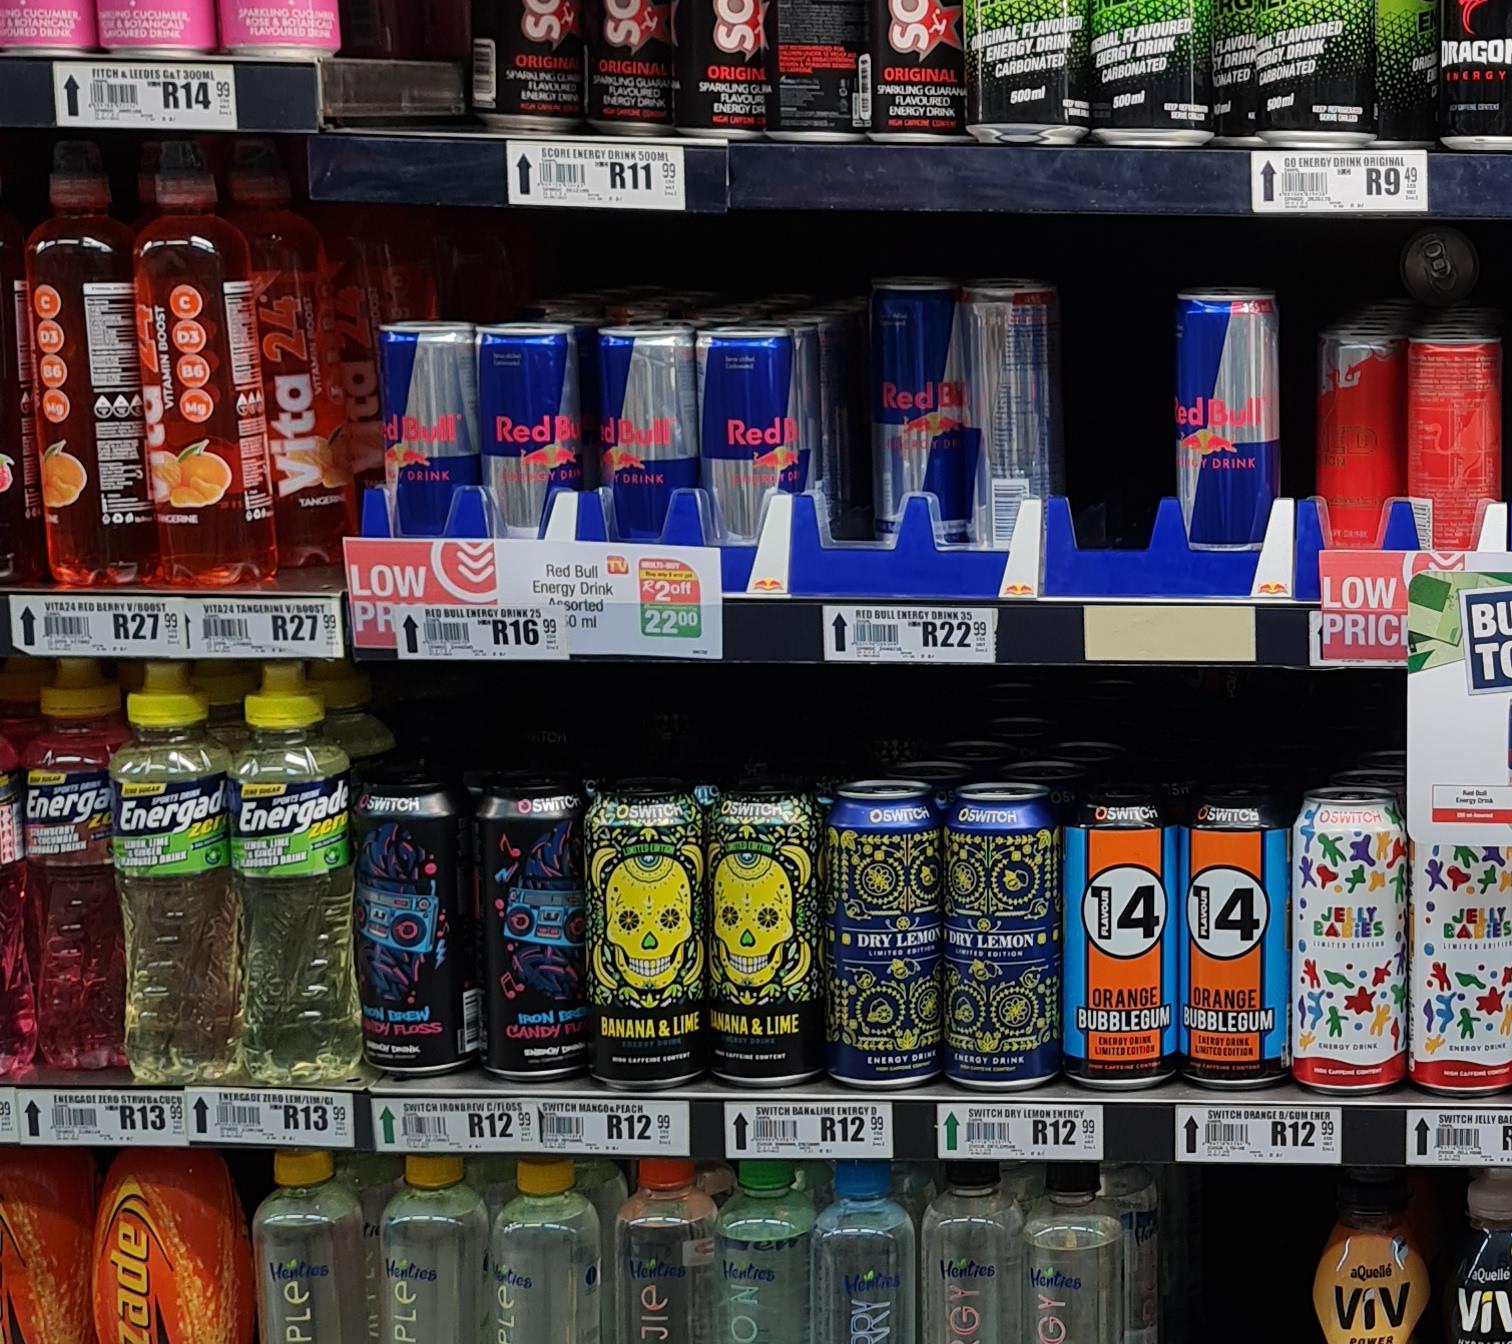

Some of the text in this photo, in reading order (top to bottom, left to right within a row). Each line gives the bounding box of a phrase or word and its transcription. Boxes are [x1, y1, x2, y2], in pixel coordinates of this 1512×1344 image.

[884, 68, 958, 82] ORIGINAL
[995, 54, 1066, 77] CARBONATED
[163, 81, 230, 109] R14 99
[1298, 157, 1331, 167] ENERGY
[1333, 157, 1361, 167] DRINK
[1363, 157, 1405, 167] ORIGINAL
[1366, 167, 1418, 196] R9 49
[402, 415, 456, 441] Bull
[496, 416, 550, 441] Red
[407, 471, 450, 481] DRINK
[351, 565, 425, 598] LOW
[546, 565, 598, 578] Red Bull
[533, 581, 613, 596] Energy Drink
[1324, 577, 1397, 608] LOW
[114, 614, 177, 639] R27 99
[923, 622, 986, 647] R22 99
[1324, 614, 1399, 646] PRIC
[239, 781, 348, 834] Energade
[368, 798, 420, 811] SWITCH
[308, 811, 348, 839] zero
[1092, 886, 1159, 939] 14
[1320, 907, 1377, 923] JELLY
[949, 932, 1035, 948] DRY LEMON
[1093, 986, 1157, 1007] ORANGE
[601, 1012, 699, 1037] BANANA & LIME
[1078, 1005, 1170, 1030] BUBBLEGUM
[120, 1106, 183, 1130] R13 99
[968, 1109, 1084, 1119] SWITCH DRY LEMON ENERGY
[1033, 1120, 1095, 1145] R12 99
[270, 1260, 328, 1282] Henties
